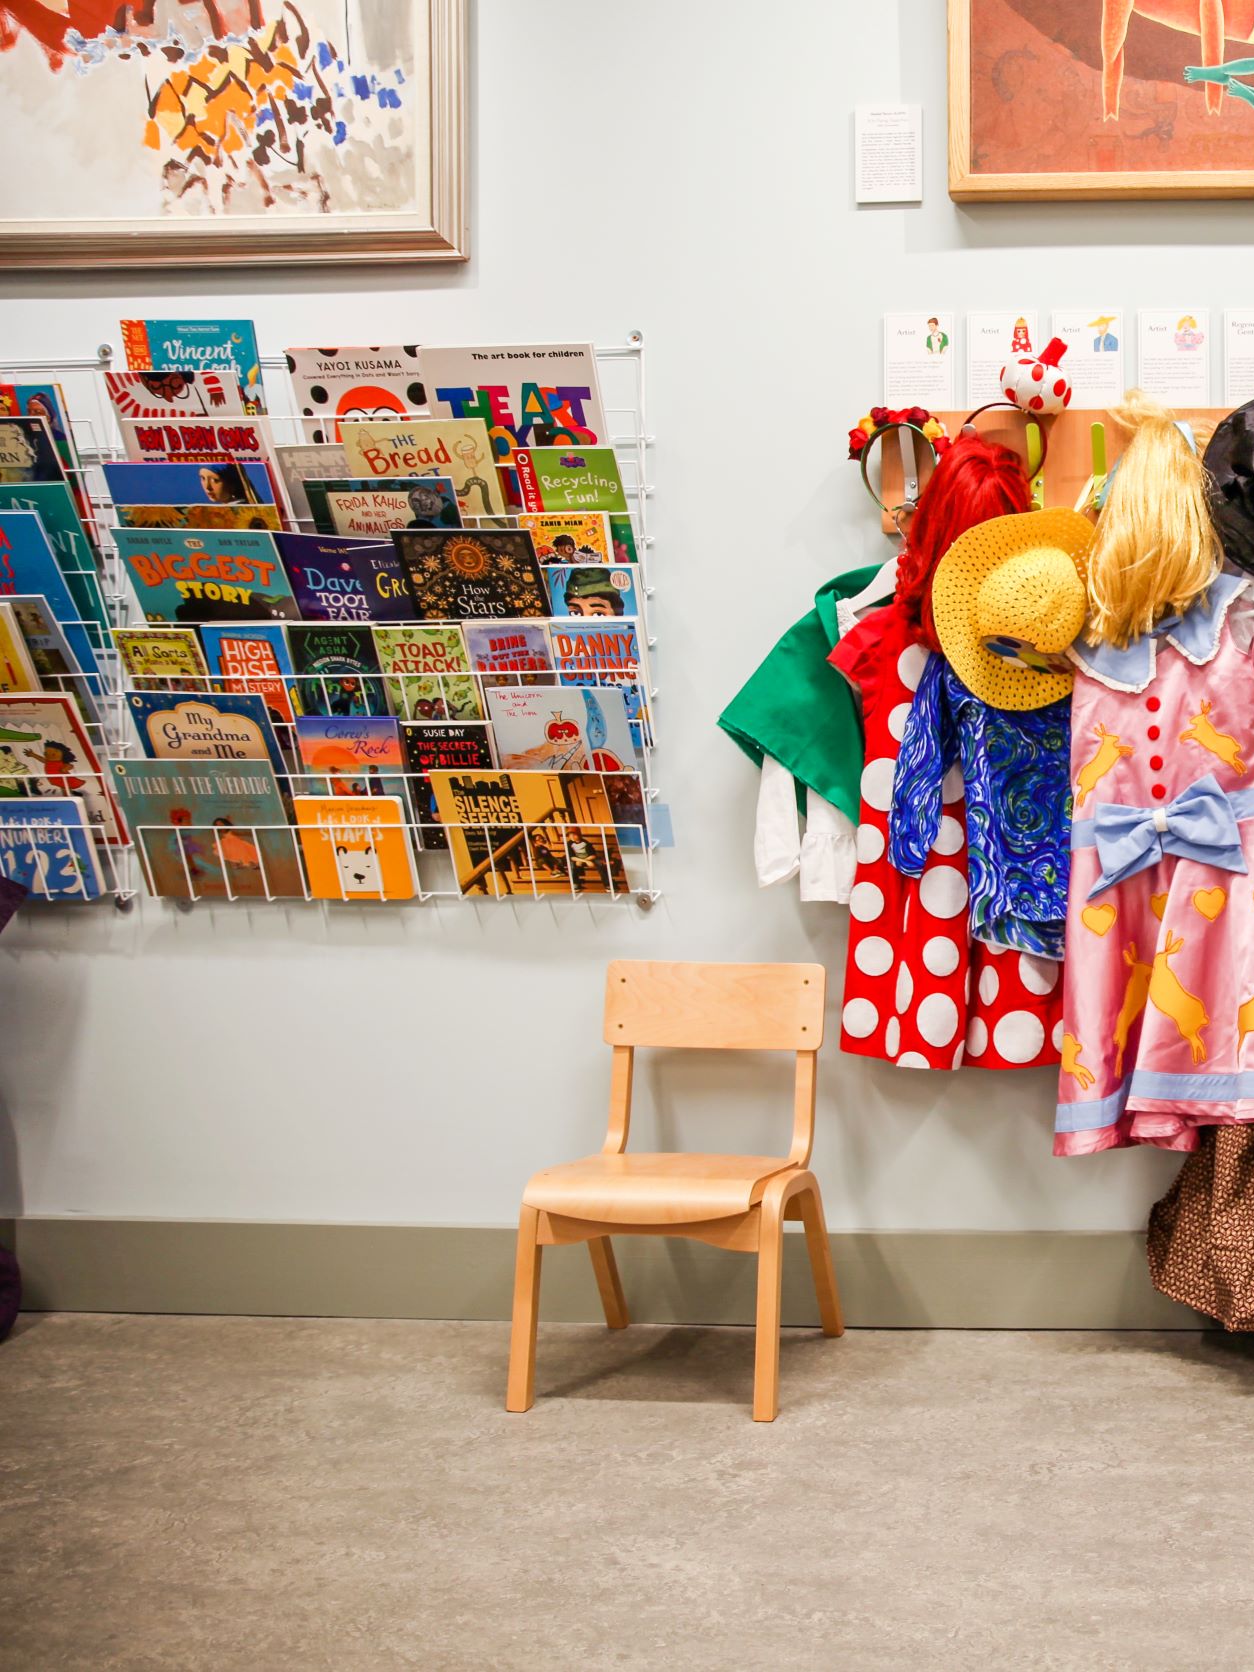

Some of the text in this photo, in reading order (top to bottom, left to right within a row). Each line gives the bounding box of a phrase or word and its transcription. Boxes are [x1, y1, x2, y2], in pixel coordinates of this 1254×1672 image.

[163, 340, 235, 361] Vincent
[471, 353, 489, 361] The
[507, 351, 530, 359] book
[532, 351, 546, 359] for
[548, 350, 584, 359] children
[316, 359, 402, 371] YAYOI KUSAMA
[435, 382, 592, 432] THE ART
[134, 426, 260, 451] HOW TO DRAW COMICS
[390, 434, 417, 449] THE
[363, 437, 453, 475] Bread
[521, 466, 534, 491] Read
[528, 492, 536, 500] it
[541, 472, 617, 493] Recycling
[336, 494, 407, 512] FRIDA KAHLO
[564, 489, 599, 504] Fun!
[348, 518, 405, 534] ANIMALITOS
[128, 552, 276, 587] BIGGEST
[175, 580, 253, 605] STORY
[462, 585, 490, 595] How
[457, 596, 506, 615] Stars
[314, 637, 347, 645] AGENT
[489, 634, 527, 652] BRING
[557, 632, 634, 657] DANNY
[151, 645, 187, 659] Sorts
[221, 640, 273, 661] HIGH
[320, 646, 348, 655] ASHA
[395, 642, 446, 659] TOAD
[391, 657, 462, 673] ATTACK!
[561, 656, 639, 682] CHUNG
[185, 712, 213, 732] My
[162, 722, 252, 749] Grandma
[324, 725, 371, 740] Corey's
[422, 728, 465, 737] SUSIE DAY
[191, 744, 247, 759] and Me
[347, 735, 394, 758] Rock
[417, 742, 479, 750] THE SECRETS
[419, 753, 481, 766] OF BILLIE
[172, 777, 188, 795] AT
[187, 777, 215, 795] THE
[214, 774, 271, 796] WEDDING
[454, 796, 521, 813] SILENCE
[460, 813, 522, 829] SEEKER
[0, 829, 69, 848] NUMBER
